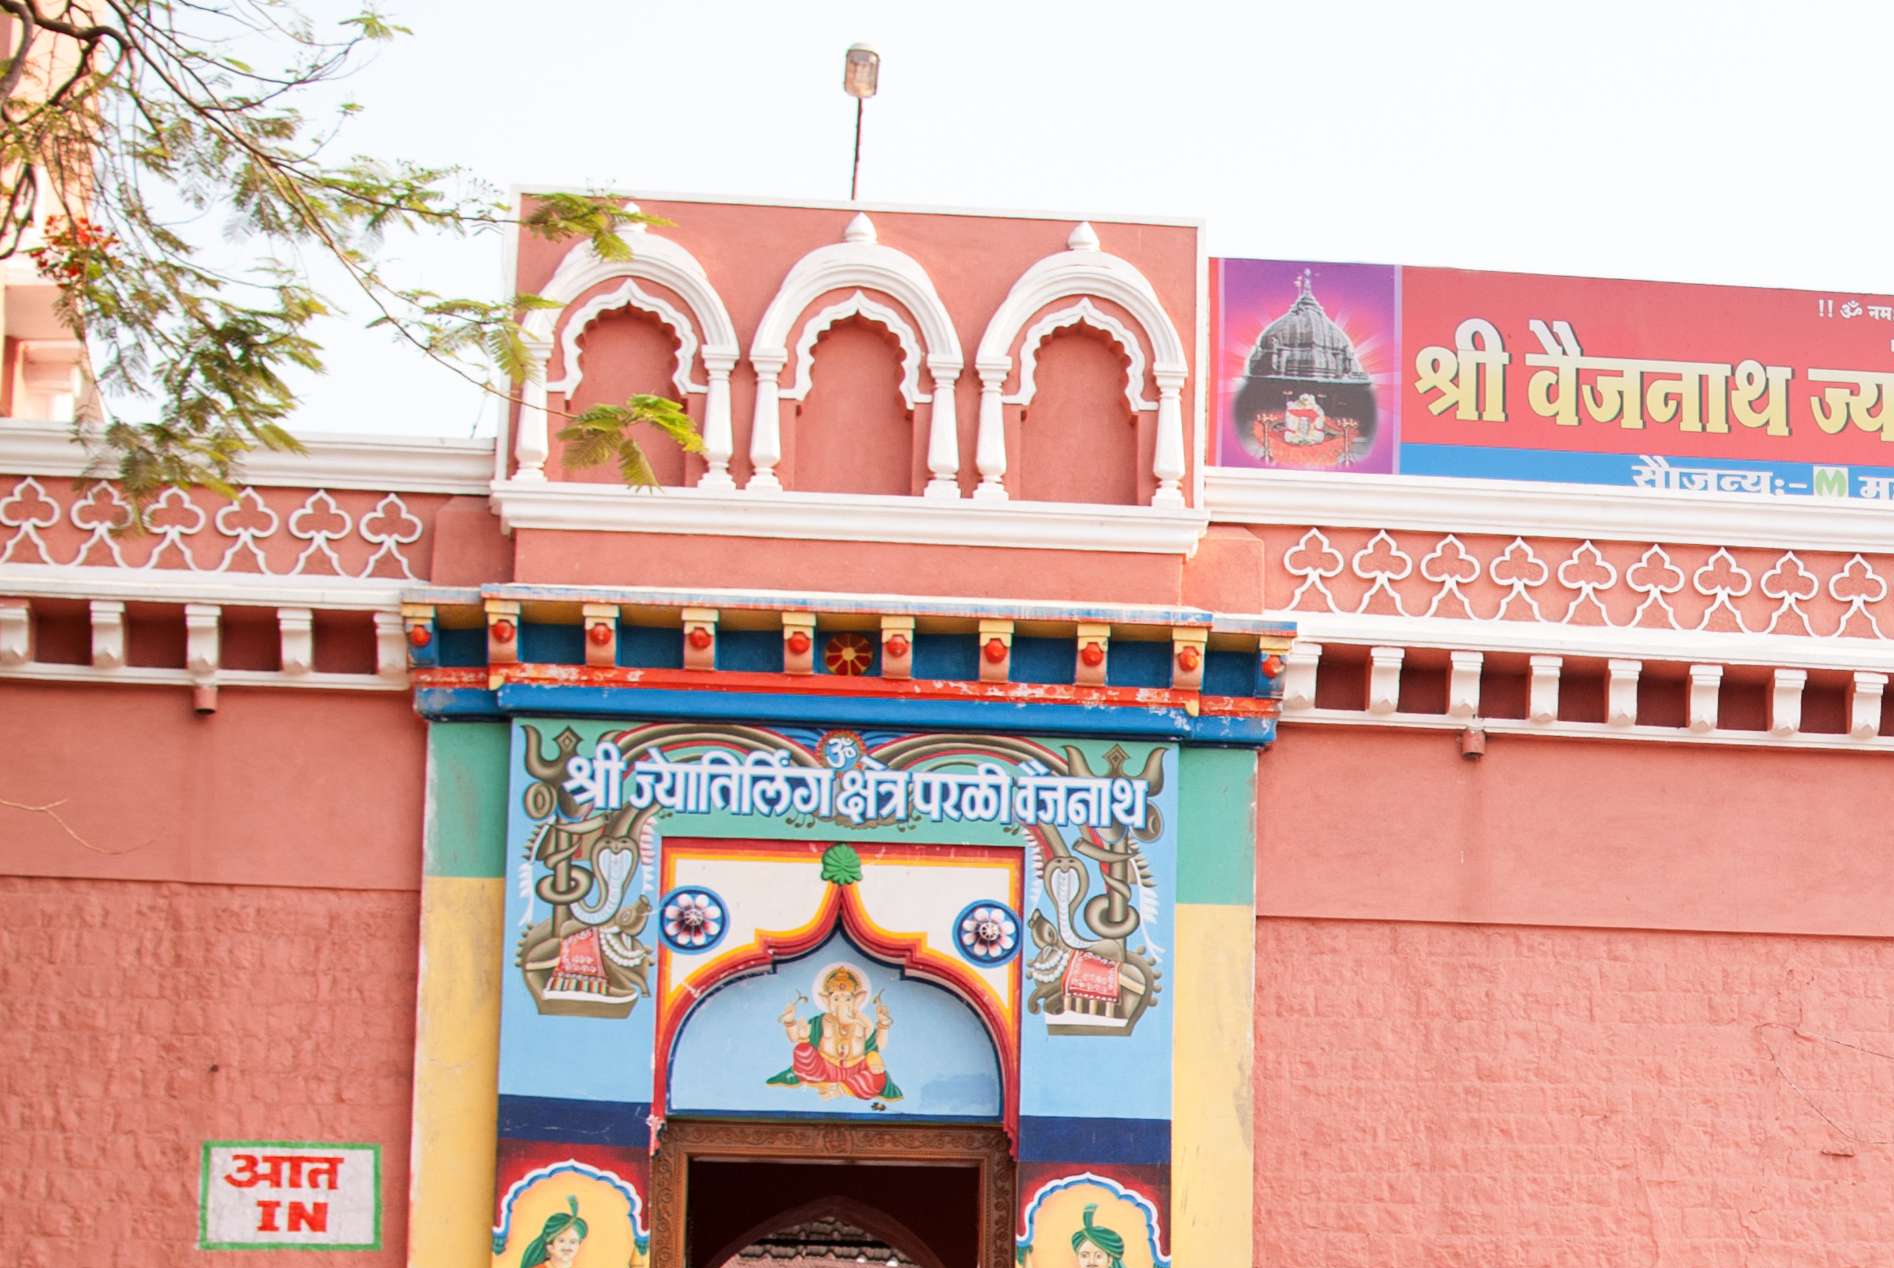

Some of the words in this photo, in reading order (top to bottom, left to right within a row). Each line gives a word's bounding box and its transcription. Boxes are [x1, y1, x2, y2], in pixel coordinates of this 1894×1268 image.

[1415, 318, 1510, 422] श्री
[1525, 319, 1794, 437] वैजनाथ
[562, 742, 627, 810] श्री
[837, 754, 911, 824] क्षेत्र
[912, 762, 1013, 825] परळी
[1014, 757, 1149, 829] वैजनाथ
[224, 1154, 345, 1190] आत
[256, 1200, 328, 1232] IN
